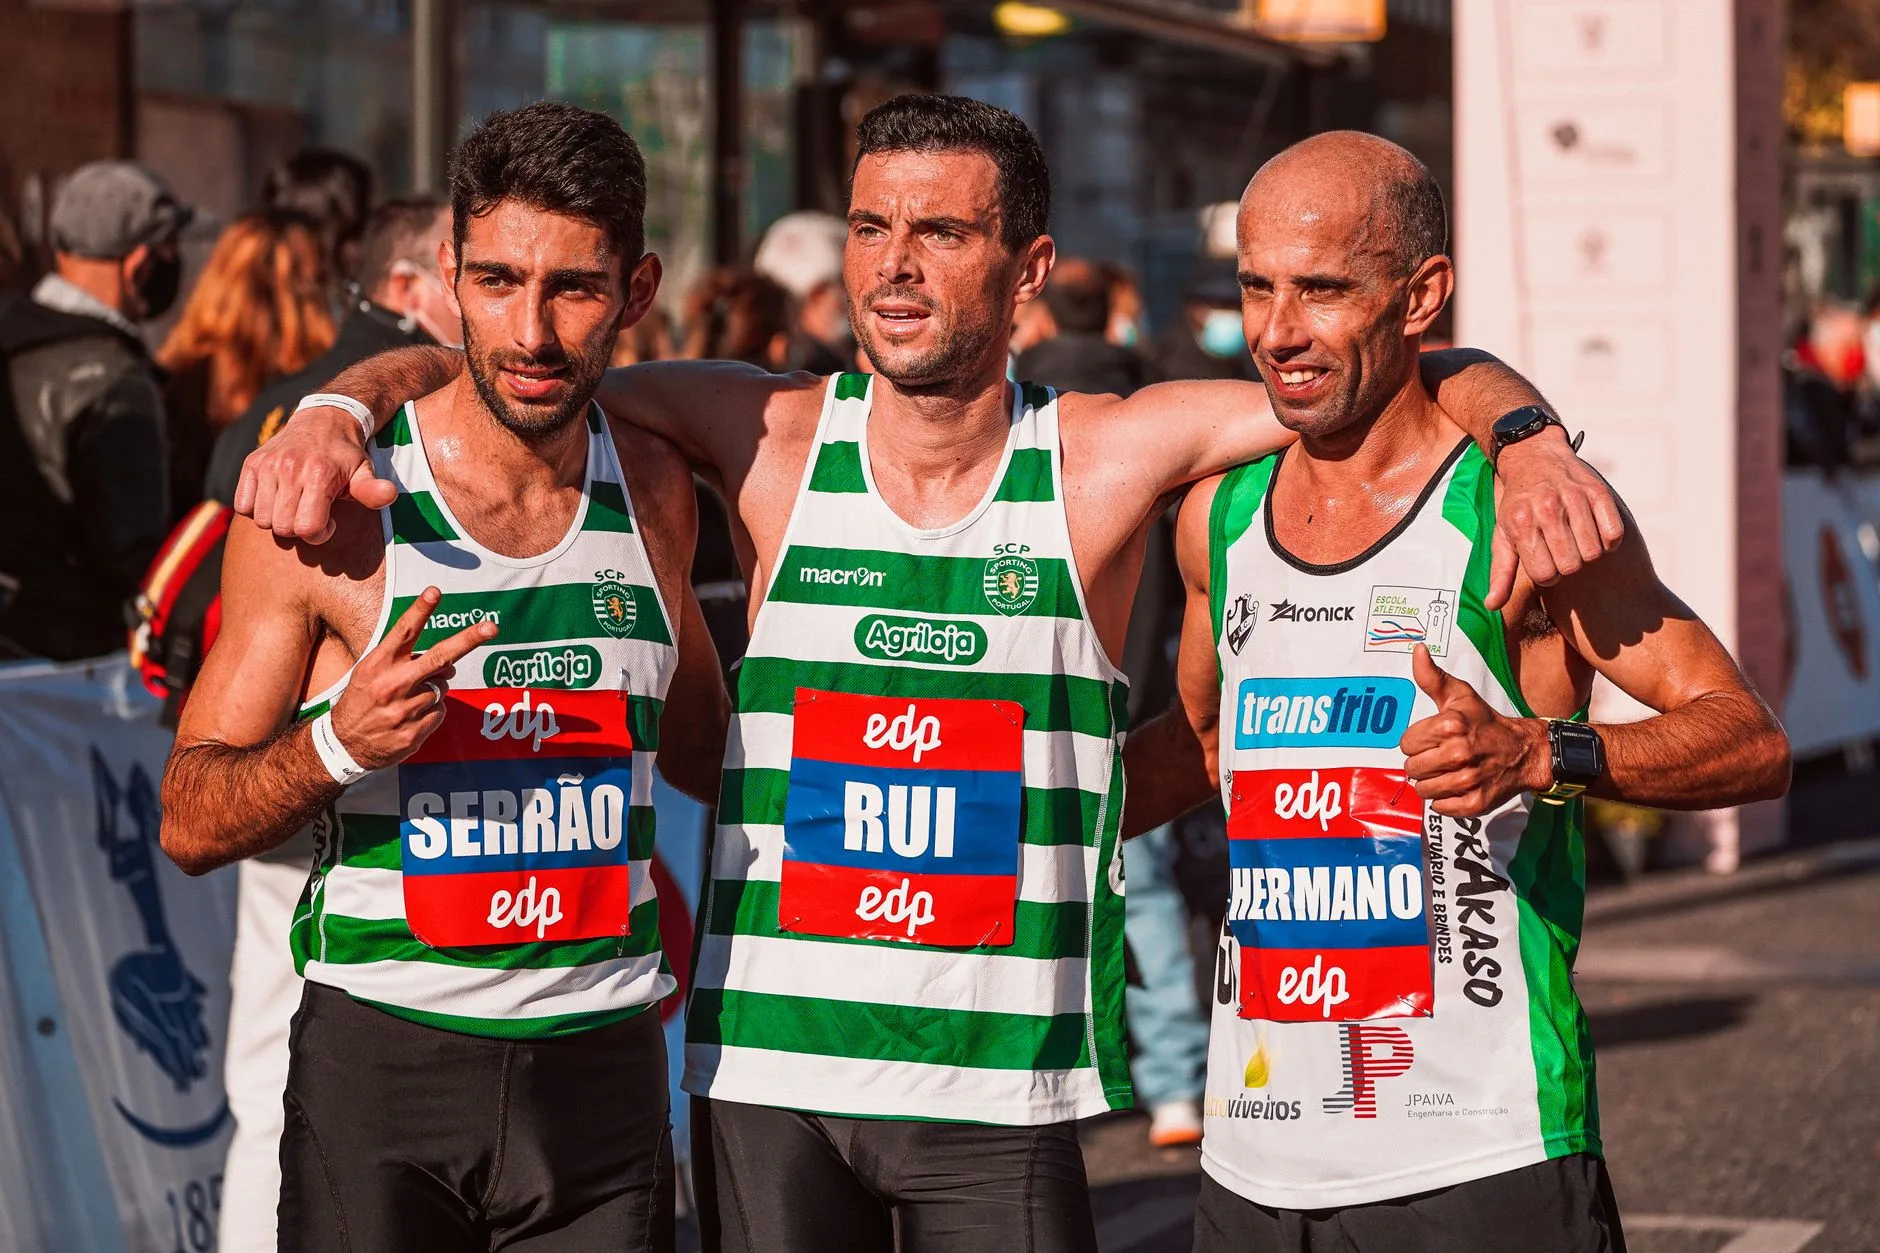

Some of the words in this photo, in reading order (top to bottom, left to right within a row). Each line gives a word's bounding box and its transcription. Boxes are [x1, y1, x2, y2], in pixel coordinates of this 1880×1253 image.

[989, 560, 1033, 574] SPORTING
[993, 543, 1031, 555] SCP
[594, 569, 625, 581] SCP
[596, 585, 631, 599] SPORTING
[800, 567, 884, 587] macron
[991, 598, 1030, 610] PORTUGAL
[1372, 605, 1420, 616] ATLETISMO
[1375, 595, 1407, 605] ESCOLA
[603, 621, 633, 633] PORTUGAL
[866, 620, 977, 661] Agriloja
[494, 650, 591, 687] Agriloja
[480, 691, 560, 752] edp
[1242, 687, 1399, 735] transfrio
[863, 704, 942, 763] edp
[407, 772, 625, 861] SERRÃO
[843, 780, 957, 858] RUI
[1274, 770, 1342, 832] edp
[1428, 805, 1447, 885] ESTUÁRIO
[487, 876, 564, 940] edp
[855, 877, 936, 937] edp
[1229, 863, 1422, 922] HERMANO
[1432, 889, 1446, 899] E
[1433, 904, 1452, 965] BRINDES
[1276, 954, 1350, 1018] edp
[1322, 1023, 1415, 1119] JP
[1405, 1093, 1455, 1107] JPAIVA
[1407, 1109, 1453, 1120] Engenharia
[1462, 1107, 1509, 1117] Construção
